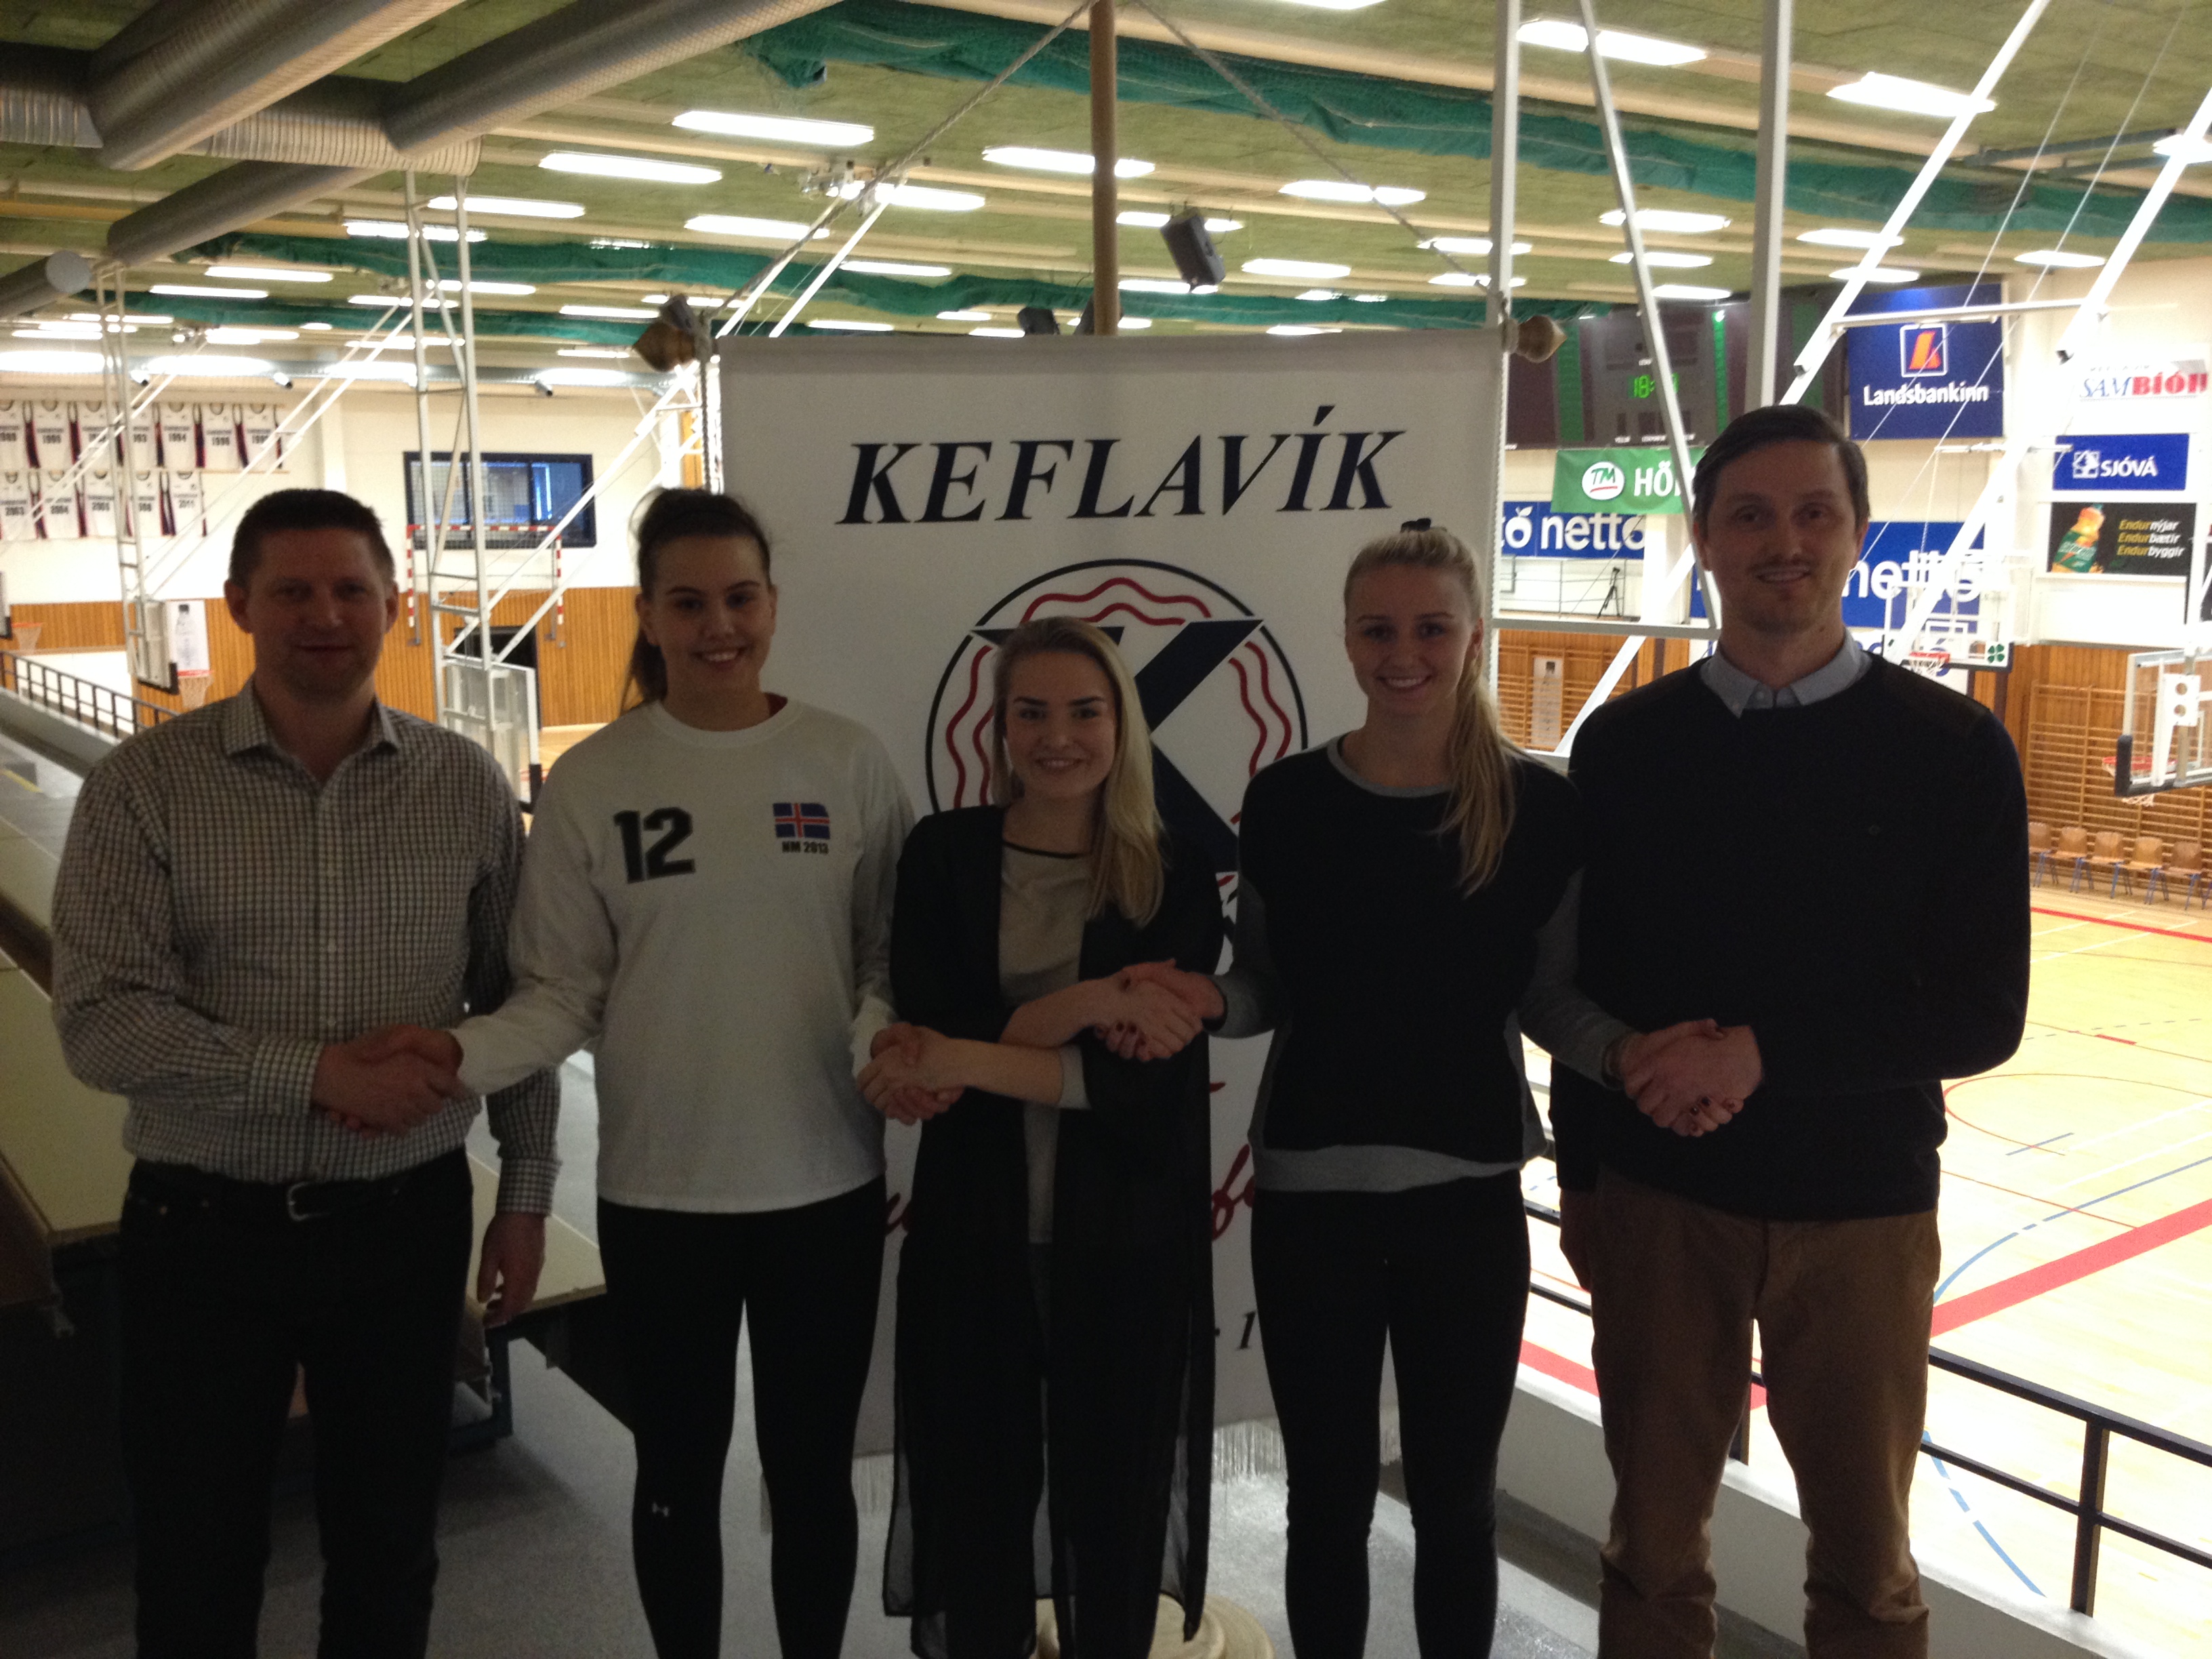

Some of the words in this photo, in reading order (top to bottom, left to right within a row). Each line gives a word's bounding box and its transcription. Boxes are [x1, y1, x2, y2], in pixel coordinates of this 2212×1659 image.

[1864, 381, 1989, 406] Landsbankinn
[836, 405, 1407, 525] KEFLAVÍK
[2100, 455, 2158, 477] SJÓVÁ
[1590, 467, 1617, 485] TM
[1633, 460, 1681, 497] HÖ
[2118, 518, 2181, 532] Endurnýjar
[2118, 532, 2181, 544] Endurbætir
[2116, 545, 2186, 558] Endurbyggir
[613, 806, 695, 884] 12
[803, 841, 829, 855] 2013
